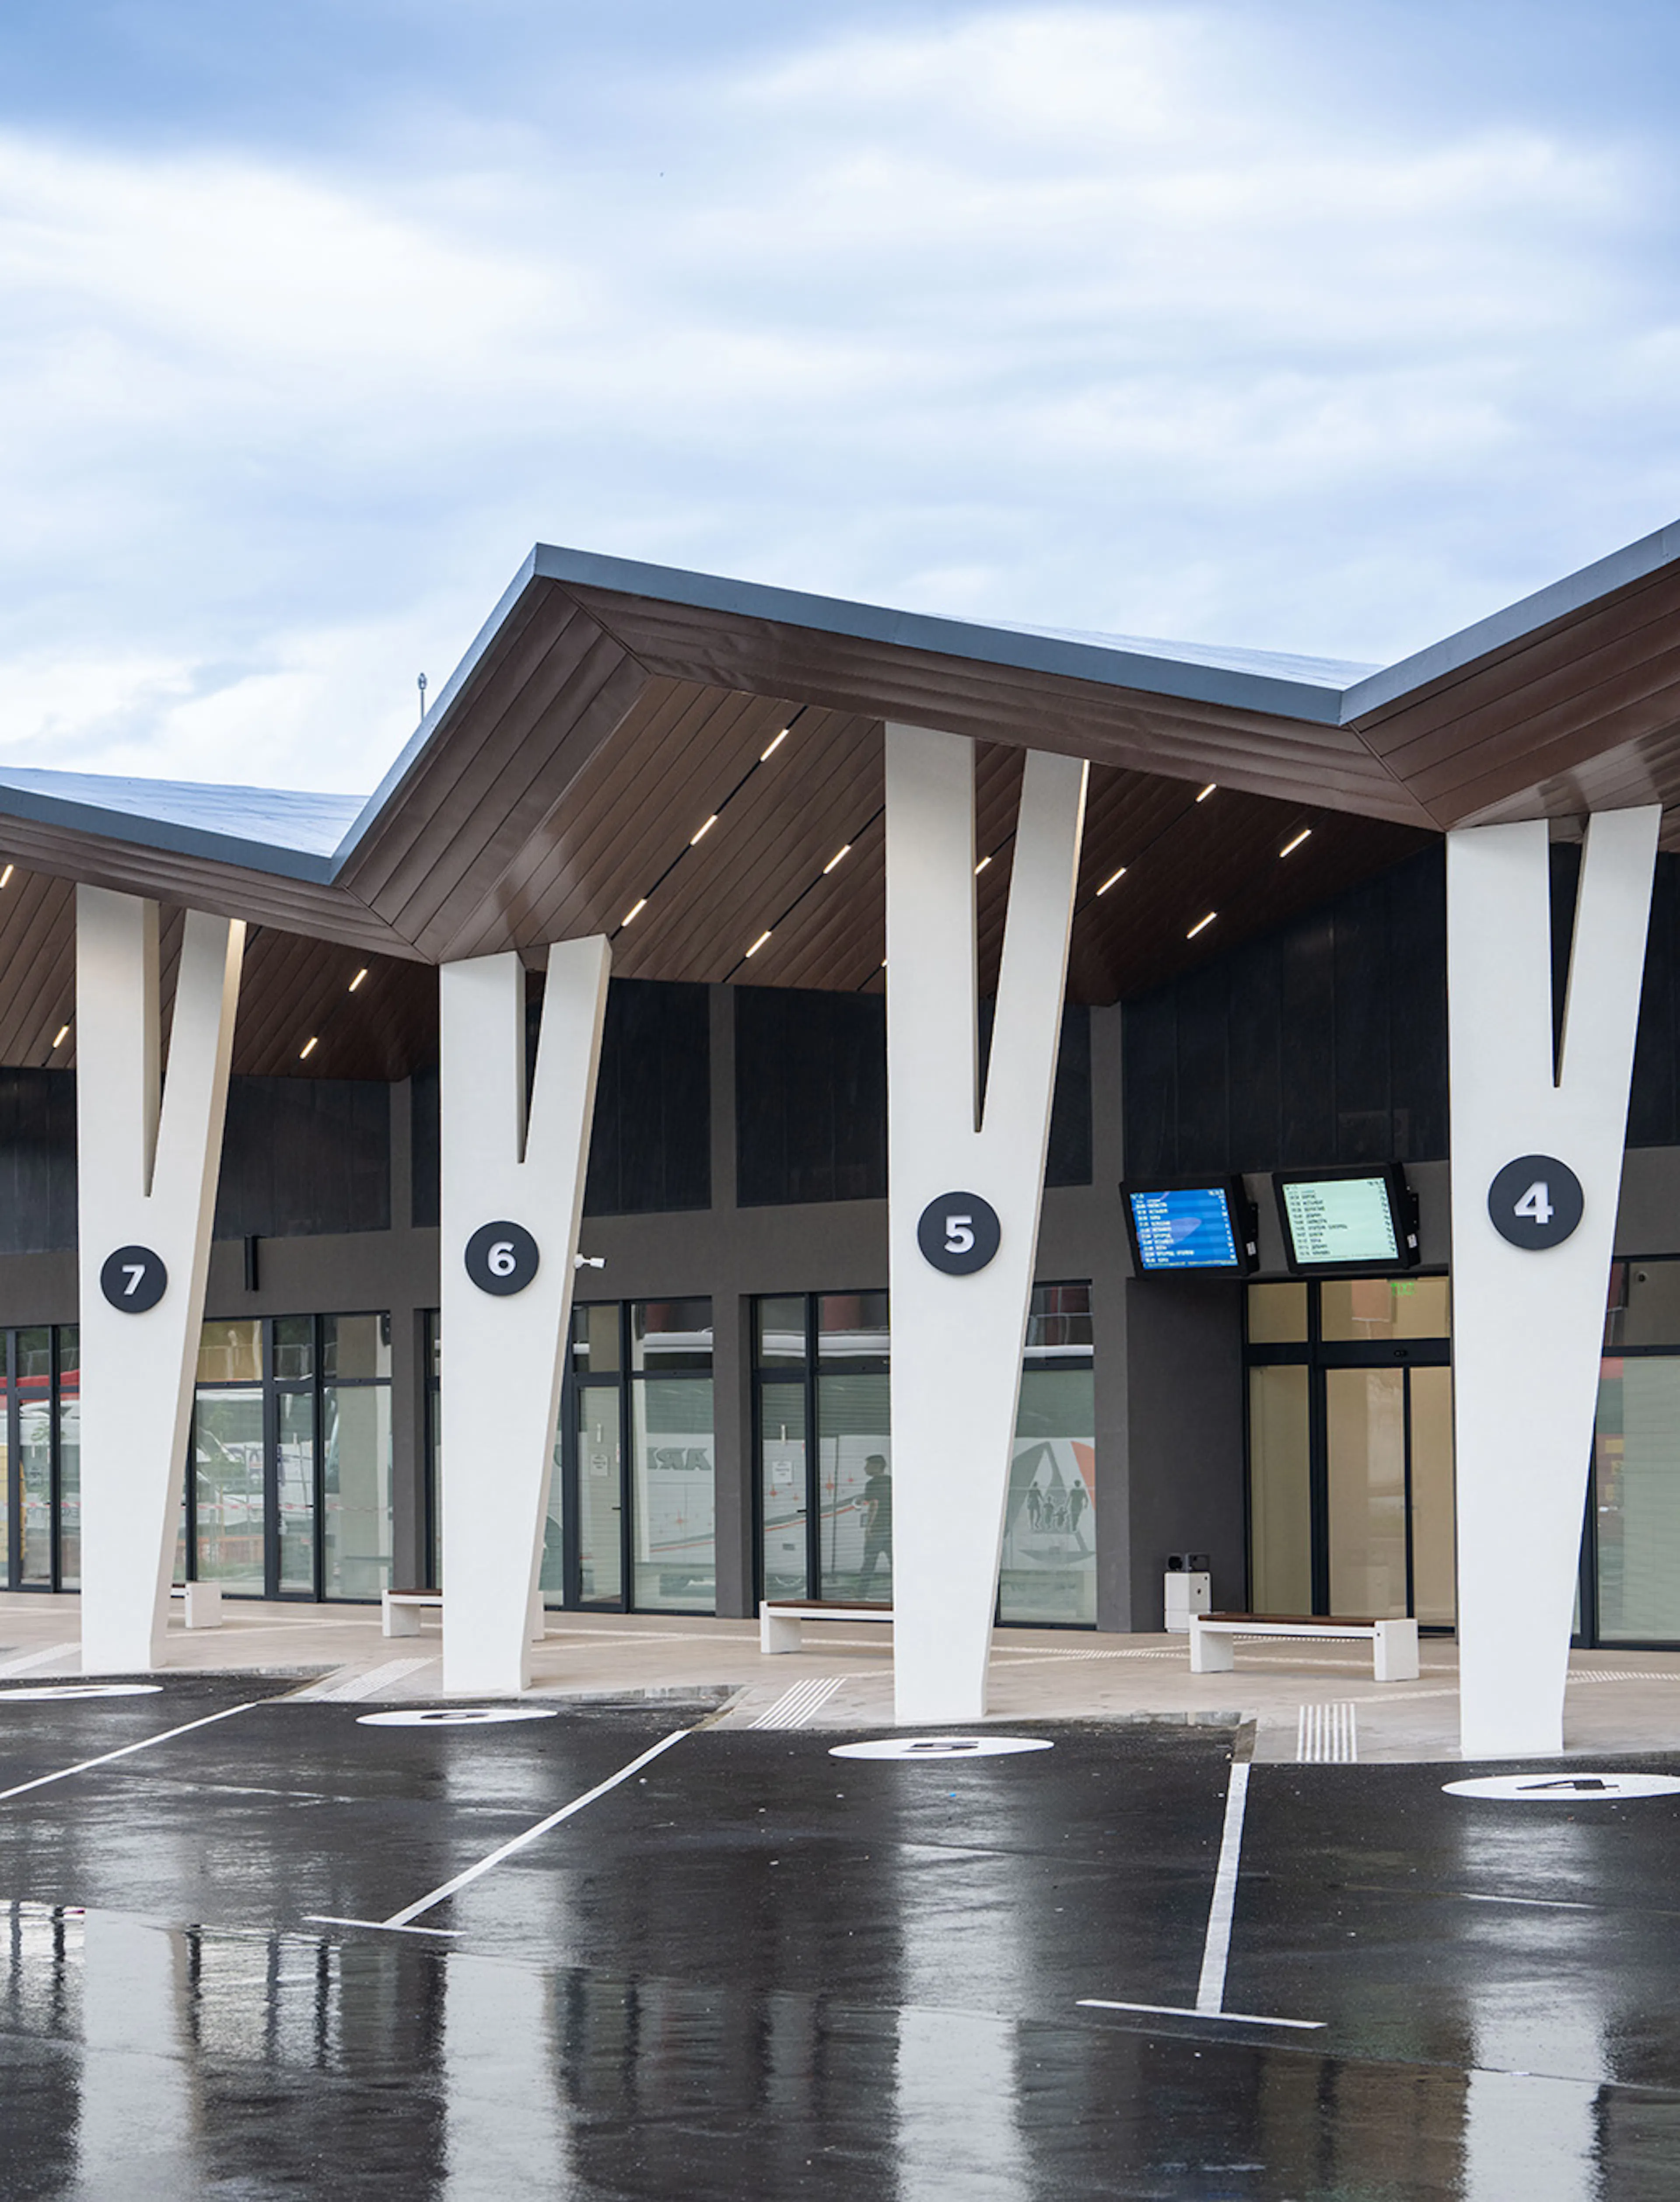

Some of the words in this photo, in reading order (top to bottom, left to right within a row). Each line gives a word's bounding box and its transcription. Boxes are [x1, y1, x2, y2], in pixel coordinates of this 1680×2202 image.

[1514, 1182, 1554, 1224] 4
[944, 1215, 975, 1254] 5
[488, 1241, 516, 1277] 6
[122, 1264, 146, 1296] 7
[902, 1741, 979, 1753] 5
[1516, 1778, 1619, 1791] 4
